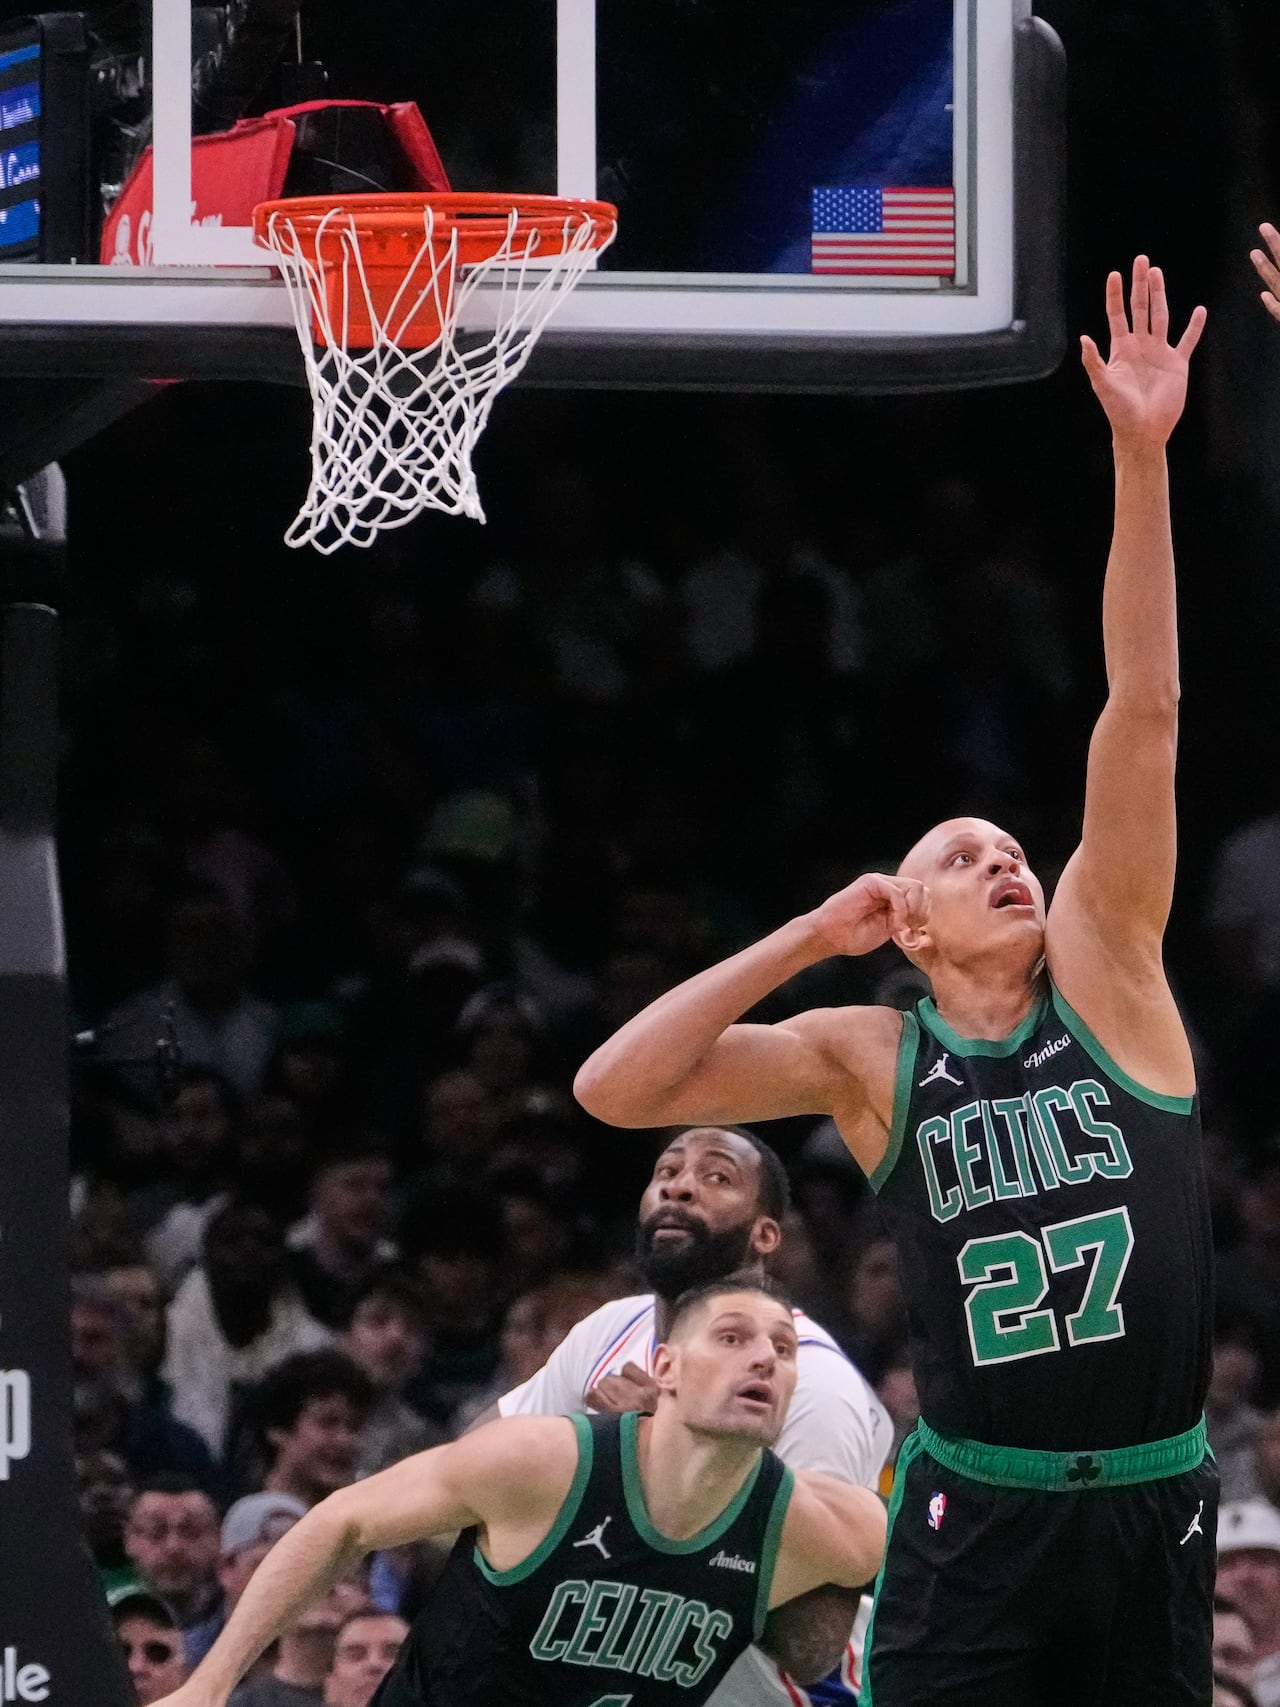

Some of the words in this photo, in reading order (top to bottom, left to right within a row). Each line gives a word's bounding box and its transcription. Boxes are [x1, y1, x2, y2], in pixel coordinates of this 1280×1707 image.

[1023, 1033, 1072, 1069] Amica
[916, 1079, 1134, 1224] CELTICS
[956, 1205, 1135, 1367] 27
[709, 1550, 755, 1575] Amica
[0, 1646, 50, 1703] le
[529, 1579, 733, 1688] CELTICS
